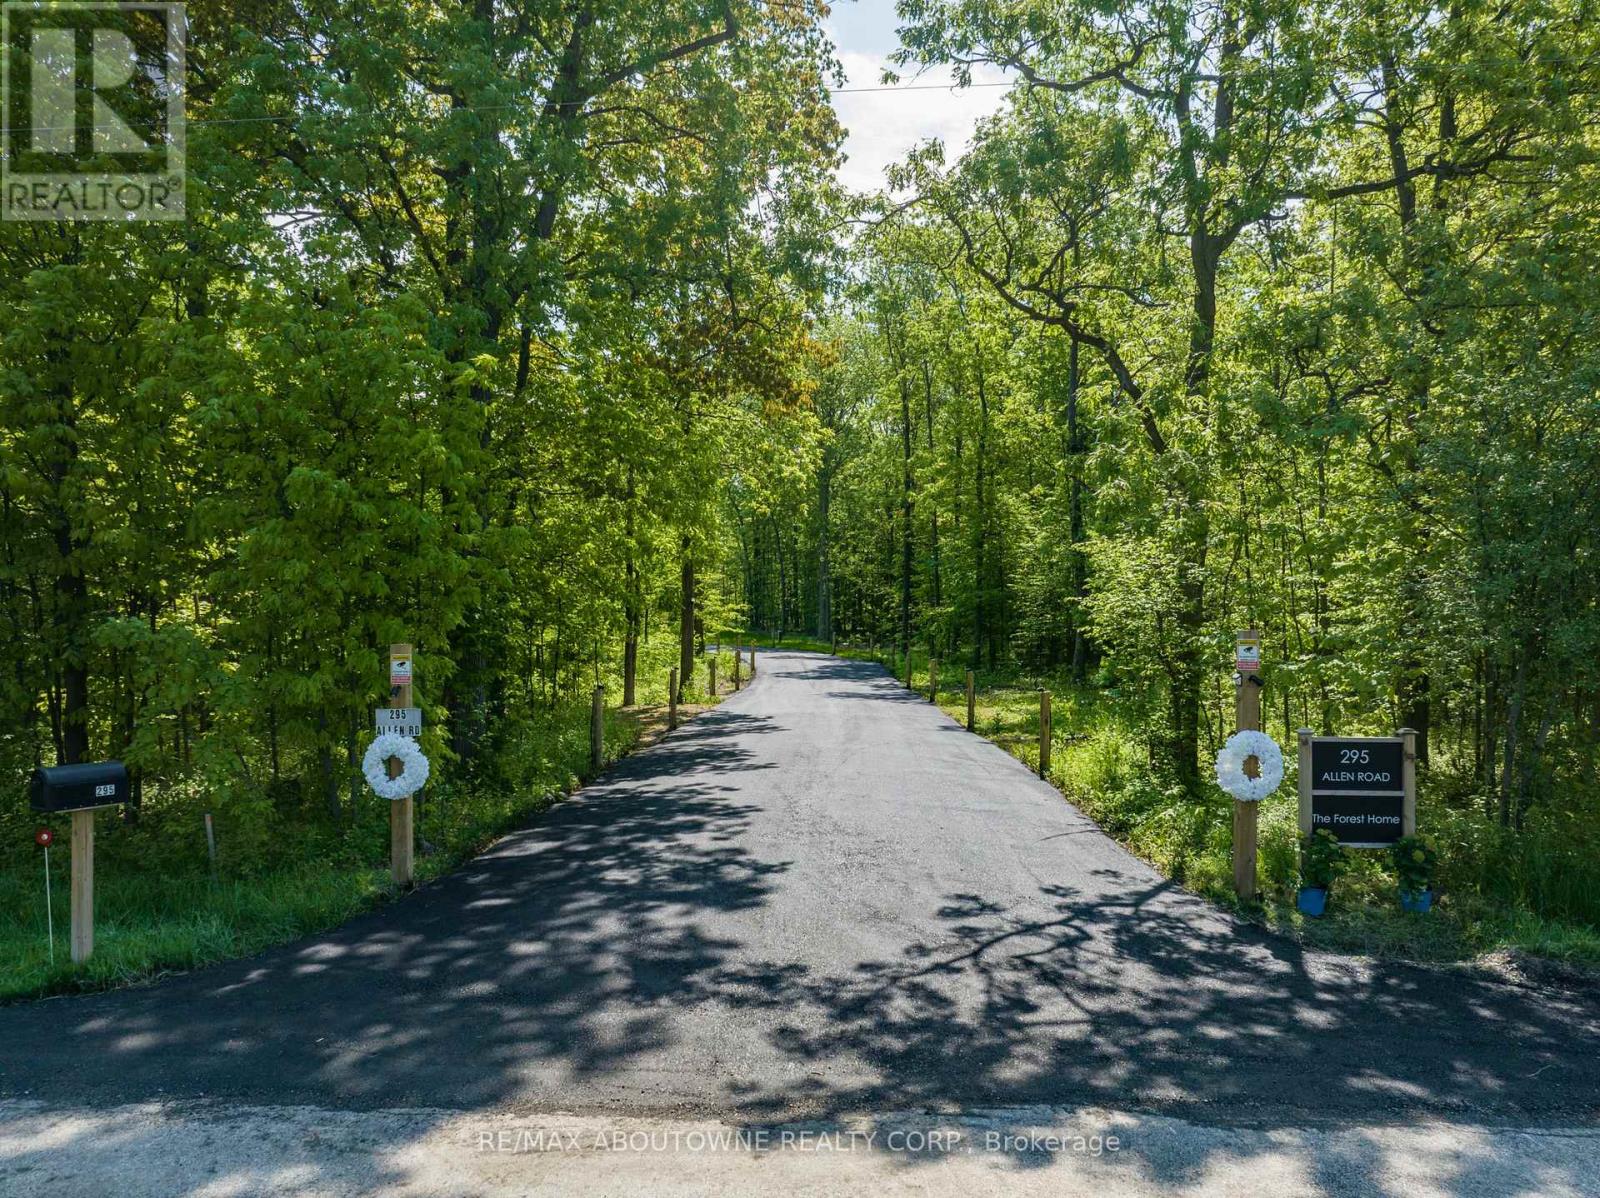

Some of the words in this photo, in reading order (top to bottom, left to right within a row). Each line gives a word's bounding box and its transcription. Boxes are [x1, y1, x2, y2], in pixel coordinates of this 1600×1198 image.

[389, 709, 407, 720] 295
[408, 725, 420, 735] RD
[1340, 749, 1370, 764] 295
[1322, 772, 1355, 782] ALLEN
[1357, 772, 1391, 782] ROAD
[96, 785, 114, 796] 295
[1312, 814, 1331, 823] The
[1333, 814, 1365, 824] Forest
[1367, 814, 1400, 824] Home
